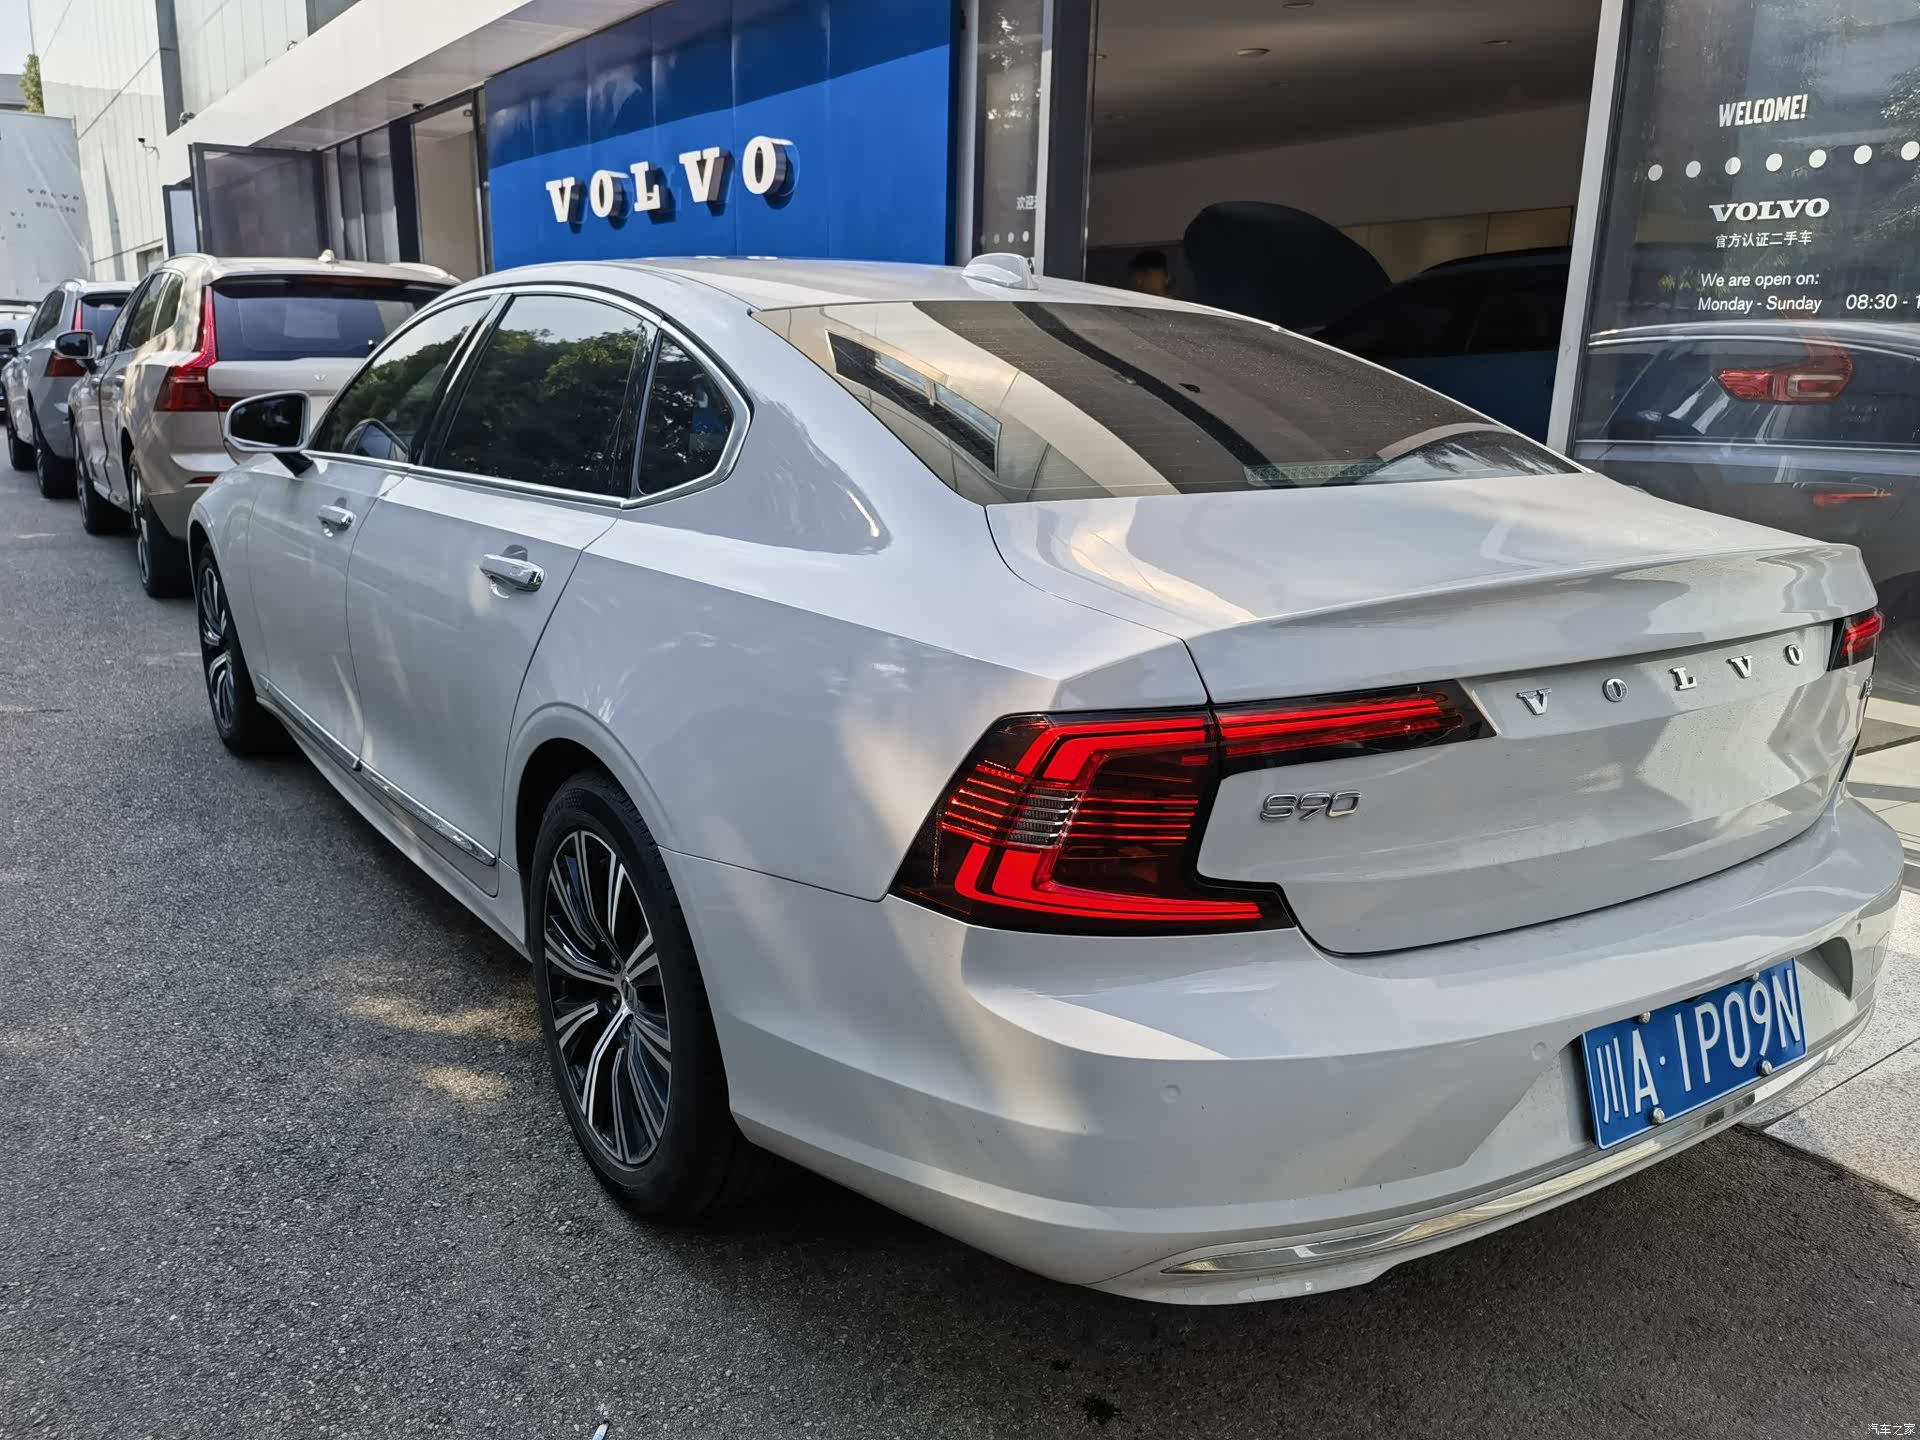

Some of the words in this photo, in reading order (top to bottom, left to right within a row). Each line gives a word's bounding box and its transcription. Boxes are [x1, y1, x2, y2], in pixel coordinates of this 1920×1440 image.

[1718, 95, 1808, 127] WELCOME!
[545, 135, 792, 223] VOLVO
[1709, 198, 1830, 222] VOLVO
[1715, 229, 1813, 249] 官方认证二手车
[1700, 273, 1725, 287] We
[1728, 275, 1751, 287] are
[1754, 274, 1792, 290] open
[1795, 273, 1820, 286] on:
[1697, 296, 1753, 314] Monday
[1766, 295, 1822, 314] Sunday
[1845, 293, 1898, 310] 08:30
[1516, 643, 1804, 716] VOLVO
[1260, 790, 1361, 821] S90
